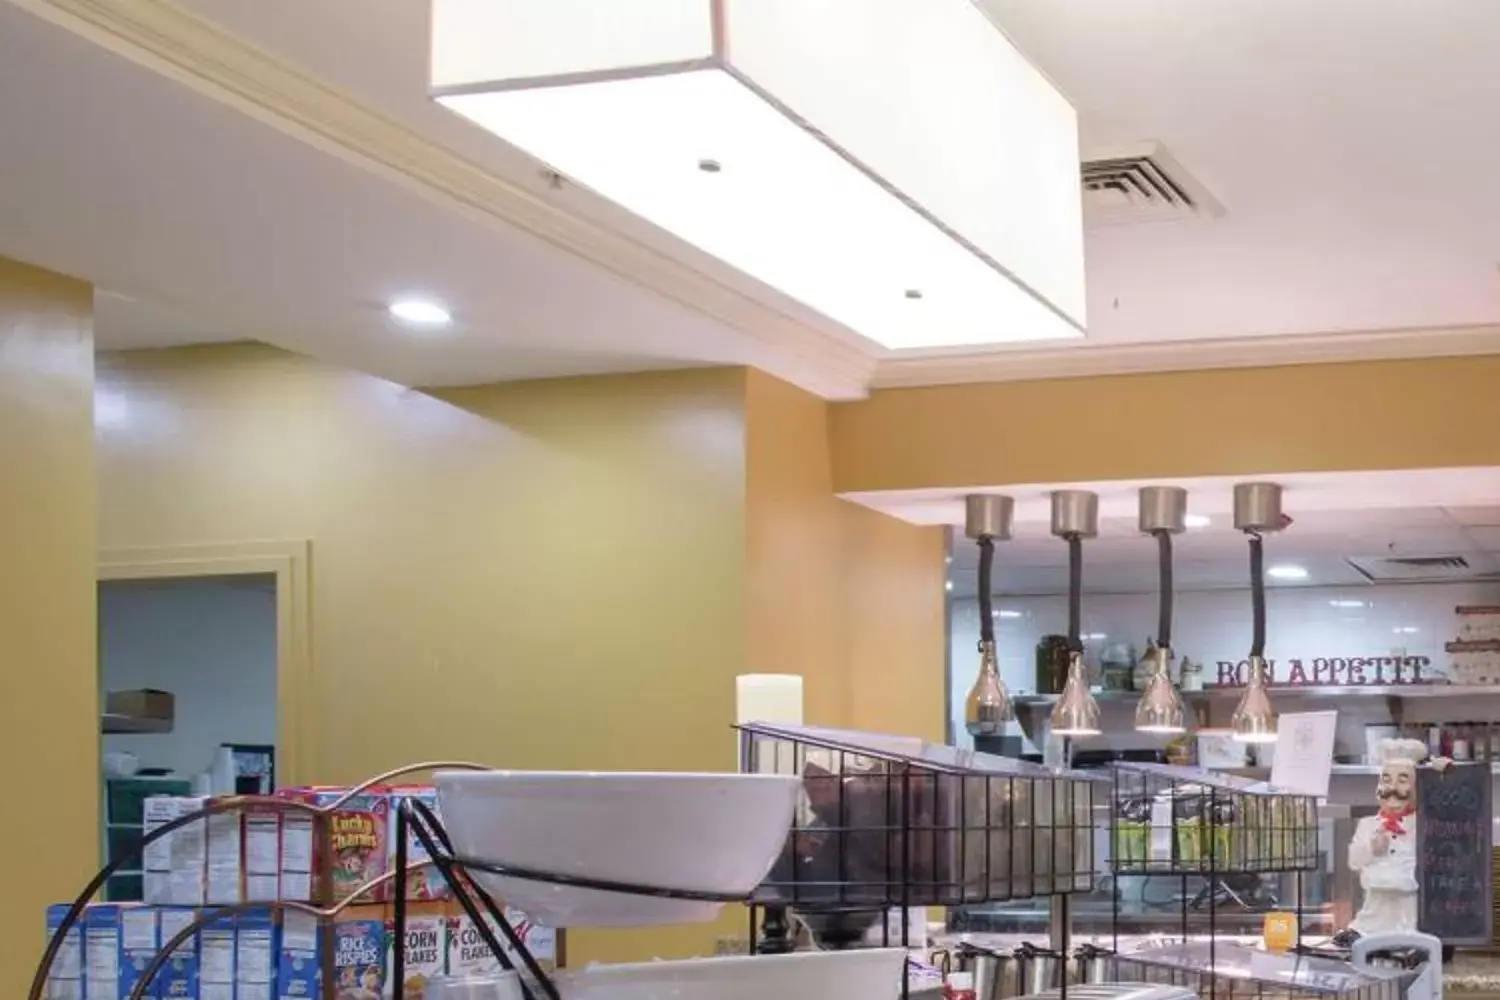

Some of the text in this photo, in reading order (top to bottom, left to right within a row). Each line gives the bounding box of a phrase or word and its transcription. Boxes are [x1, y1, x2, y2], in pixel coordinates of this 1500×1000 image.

[1216, 655, 1431, 686] BON APPETIT
[331, 814, 373, 834] Lucky
[340, 936, 365, 952] RICE
[335, 948, 378, 966] RISPIES
